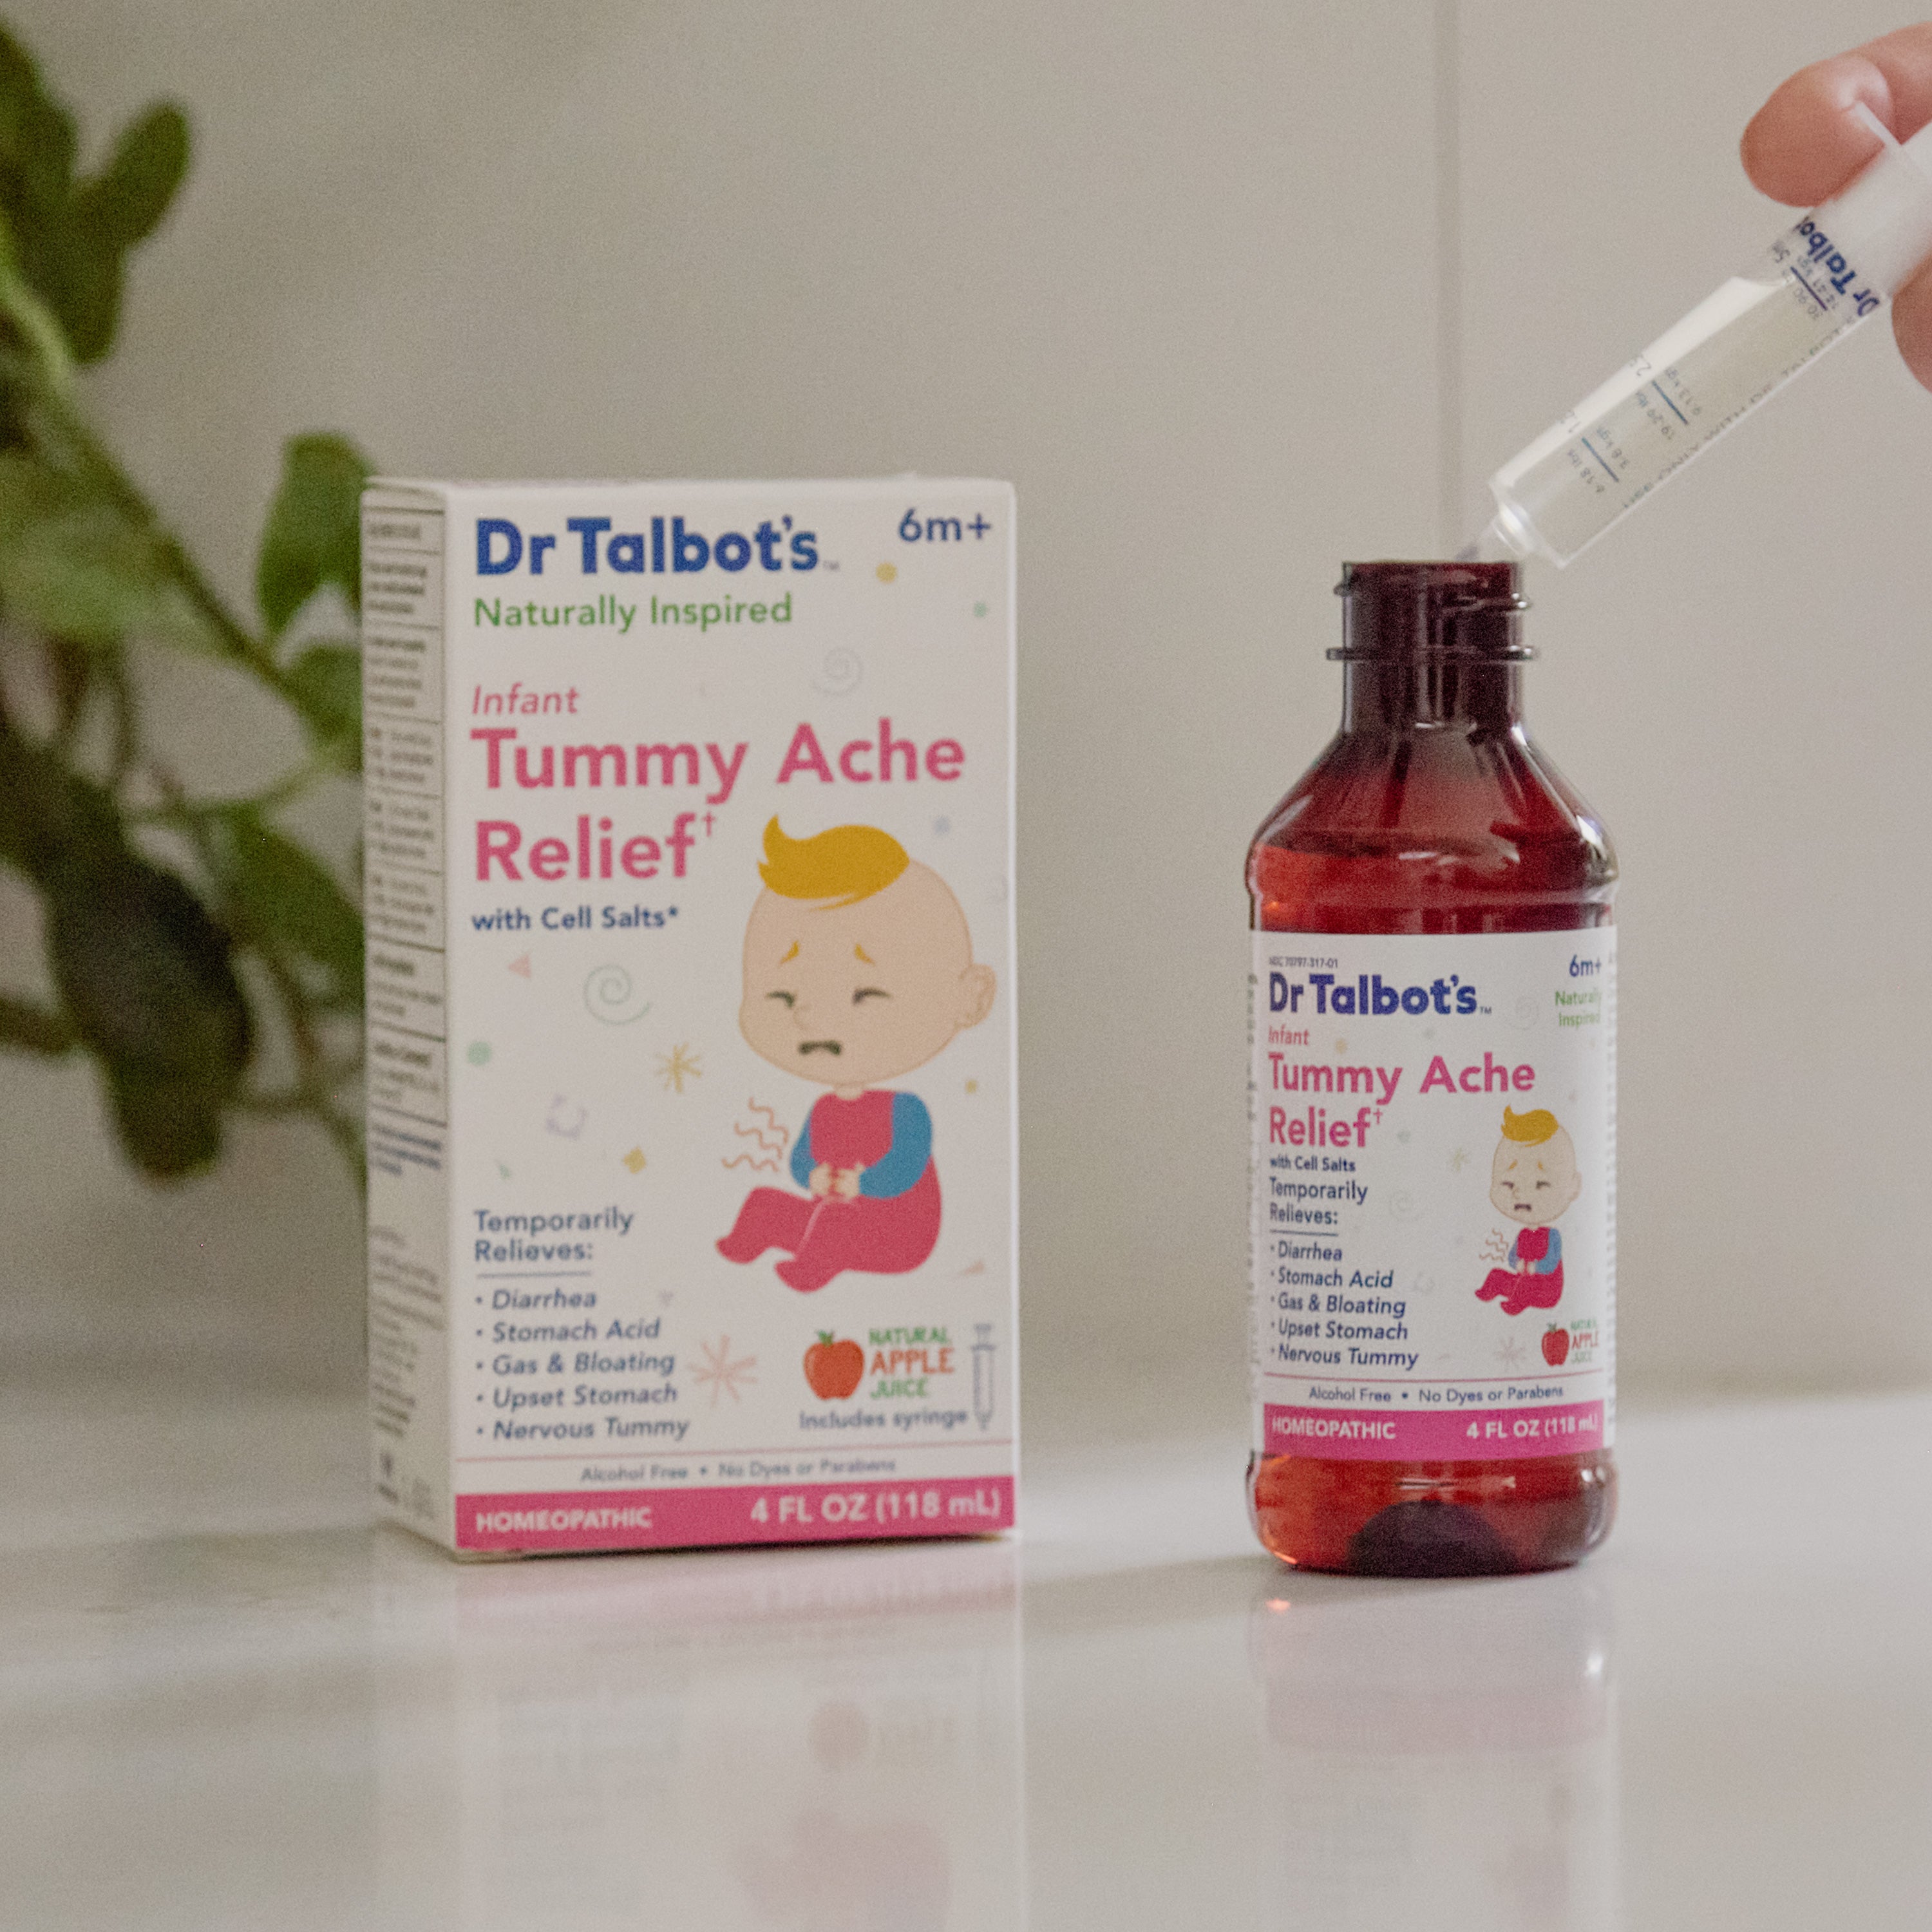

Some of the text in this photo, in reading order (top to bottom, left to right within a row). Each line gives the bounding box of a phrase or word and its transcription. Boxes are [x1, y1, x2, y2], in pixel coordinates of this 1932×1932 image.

[898, 507, 992, 544] 6m+
[476, 518, 556, 576] Dr
[474, 591, 793, 635] Naturally Inspired
[472, 681, 580, 715] Infant
[469, 727, 748, 806] Tummy
[776, 717, 965, 784] Ache
[471, 907, 531, 931] with
[540, 905, 592, 931] Cell
[1568, 954, 1600, 978] 6m+
[1269, 971, 1304, 1013] Dr
[1268, 1024, 1310, 1046] Infant
[1268, 1051, 1536, 1106] Tummy Ache
[1269, 1156, 1356, 1172] with Cell Salts
[1269, 1175, 1368, 1207] Temporarily
[473, 1205, 634, 1237] Temporarily
[1269, 1202, 1338, 1225] Relieves:
[474, 1238, 592, 1262] Relieves:
[1278, 1240, 1343, 1262] Diarrhea
[1278, 1265, 1394, 1289] Stomach Acid
[491, 1287, 598, 1311] Diarrhea
[1278, 1291, 1406, 1320] Gas & Bloating
[493, 1317, 661, 1344] Stomach Acid
[869, 1327, 952, 1345] NATURAL
[1278, 1318, 1408, 1340] Upset Stomach
[492, 1350, 676, 1378] Gas & Bloating
[870, 1346, 954, 1375] APPLE
[1278, 1343, 1419, 1371] Nervous Tummy
[493, 1382, 678, 1413] Upset Stomach
[869, 1374, 933, 1400] JUICE
[1309, 1385, 1564, 1406] Alcohol Free No Dyes or Parabens
[493, 1415, 690, 1442] Nervous Tummy
[799, 1408, 969, 1432] Includes syringe
[1271, 1417, 1397, 1440] HOMEOPATHIC
[1466, 1422, 1480, 1439] 4
[1485, 1421, 1507, 1439] FL
[1513, 1419, 1540, 1437] OZ
[580, 1466, 645, 1482] Alcohol
[650, 1464, 689, 1480] Free
[718, 1462, 745, 1478] No
[747, 1459, 794, 1484] Dyes
[796, 1463, 814, 1475] or
[750, 1488, 1001, 1523] 4 FL OZ (118 mL)
[476, 1506, 652, 1533] HOMEOPATHIC
